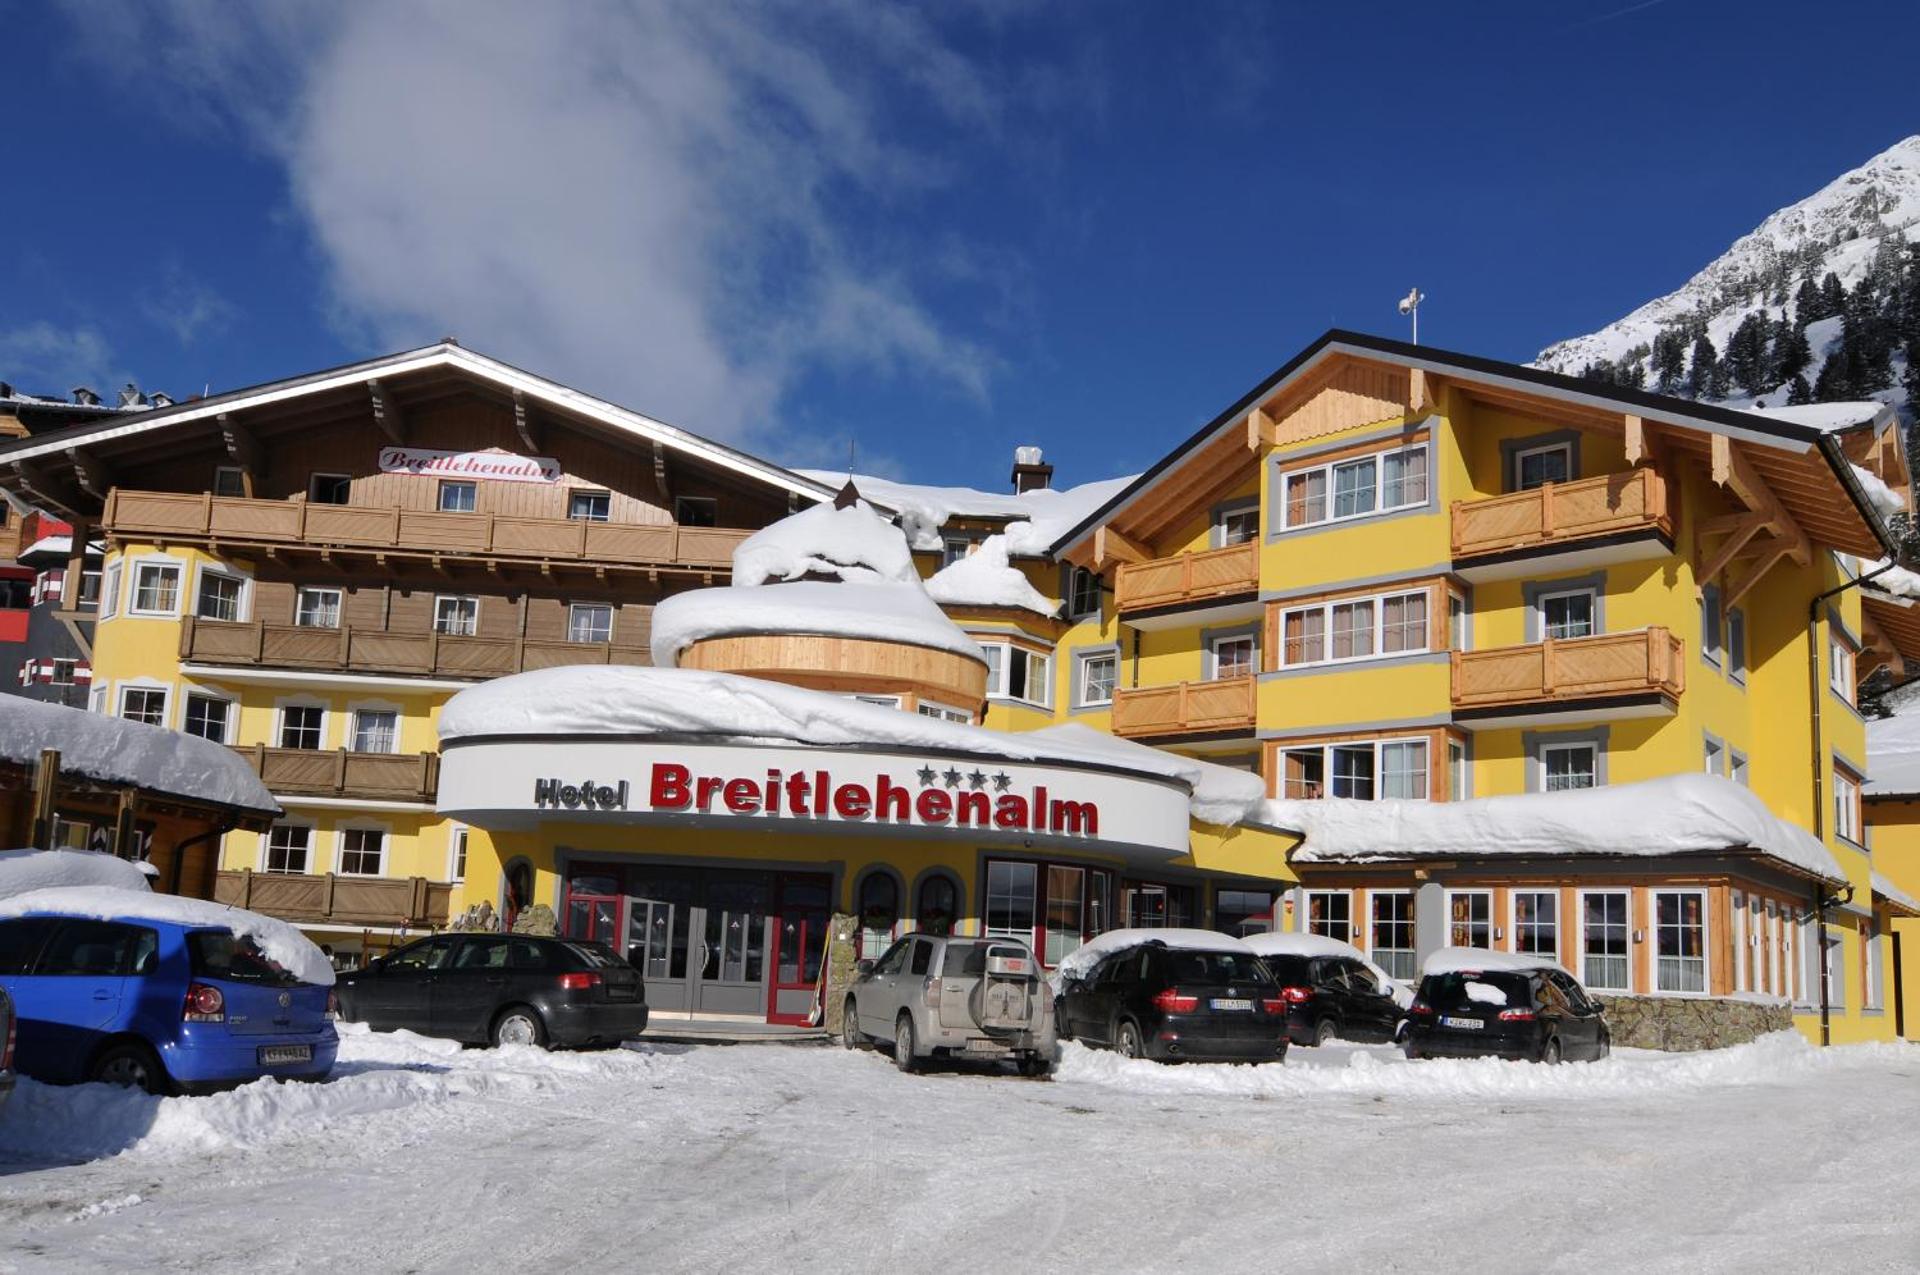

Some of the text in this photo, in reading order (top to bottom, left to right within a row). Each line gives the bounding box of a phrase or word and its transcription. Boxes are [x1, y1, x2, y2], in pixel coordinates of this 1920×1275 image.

[383, 451, 554, 477] Breitlehenalm
[534, 763, 1099, 837] Hotel Breitlehenalm
